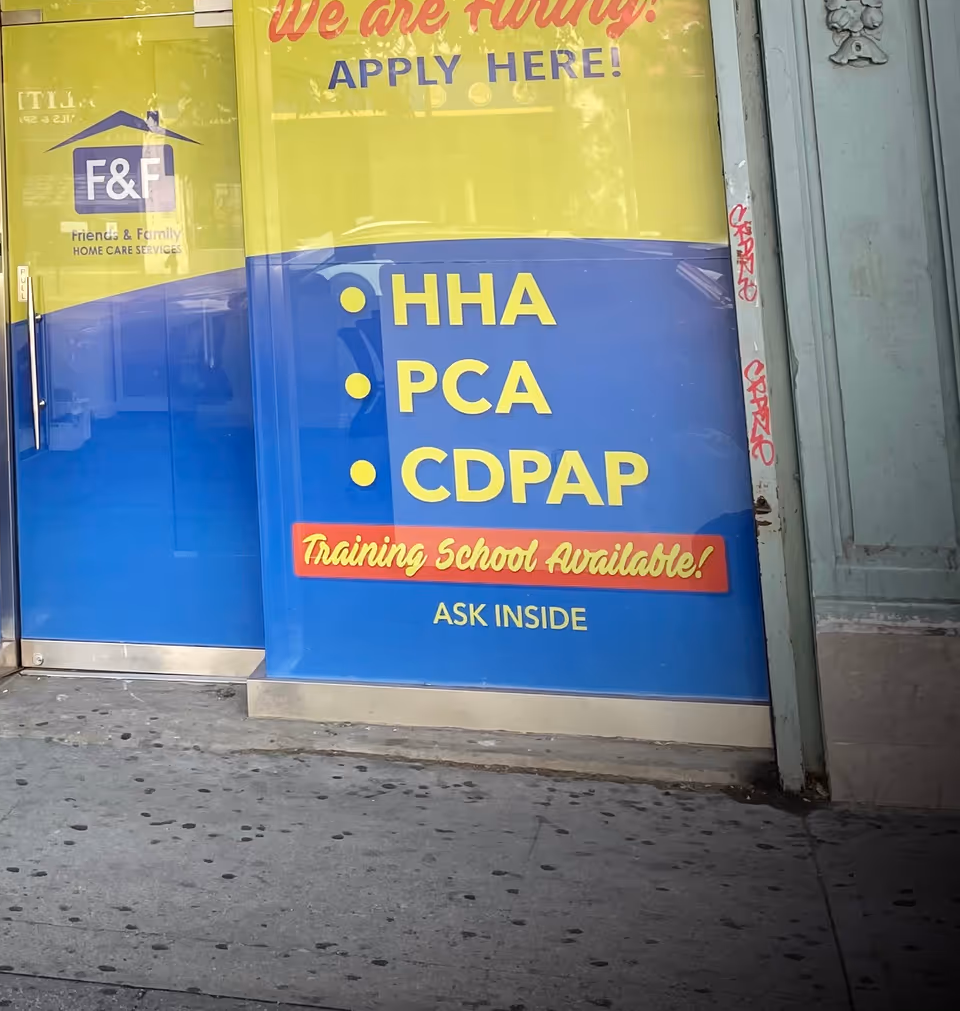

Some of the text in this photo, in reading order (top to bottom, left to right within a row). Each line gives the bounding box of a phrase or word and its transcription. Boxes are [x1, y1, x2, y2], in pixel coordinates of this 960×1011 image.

[328, 47, 621, 90] APPLY HERE!
[86, 157, 161, 201] F&F
[72, 228, 182, 242] Friends & Family
[73, 244, 182, 256] HOME CARE SERVICES
[391, 272, 557, 326] HHA
[397, 359, 553, 414] PCA
[400, 447, 649, 506] CDPAP
[302, 533, 715, 579] Training School Available!
[433, 602, 588, 631] ASK INSIDE
